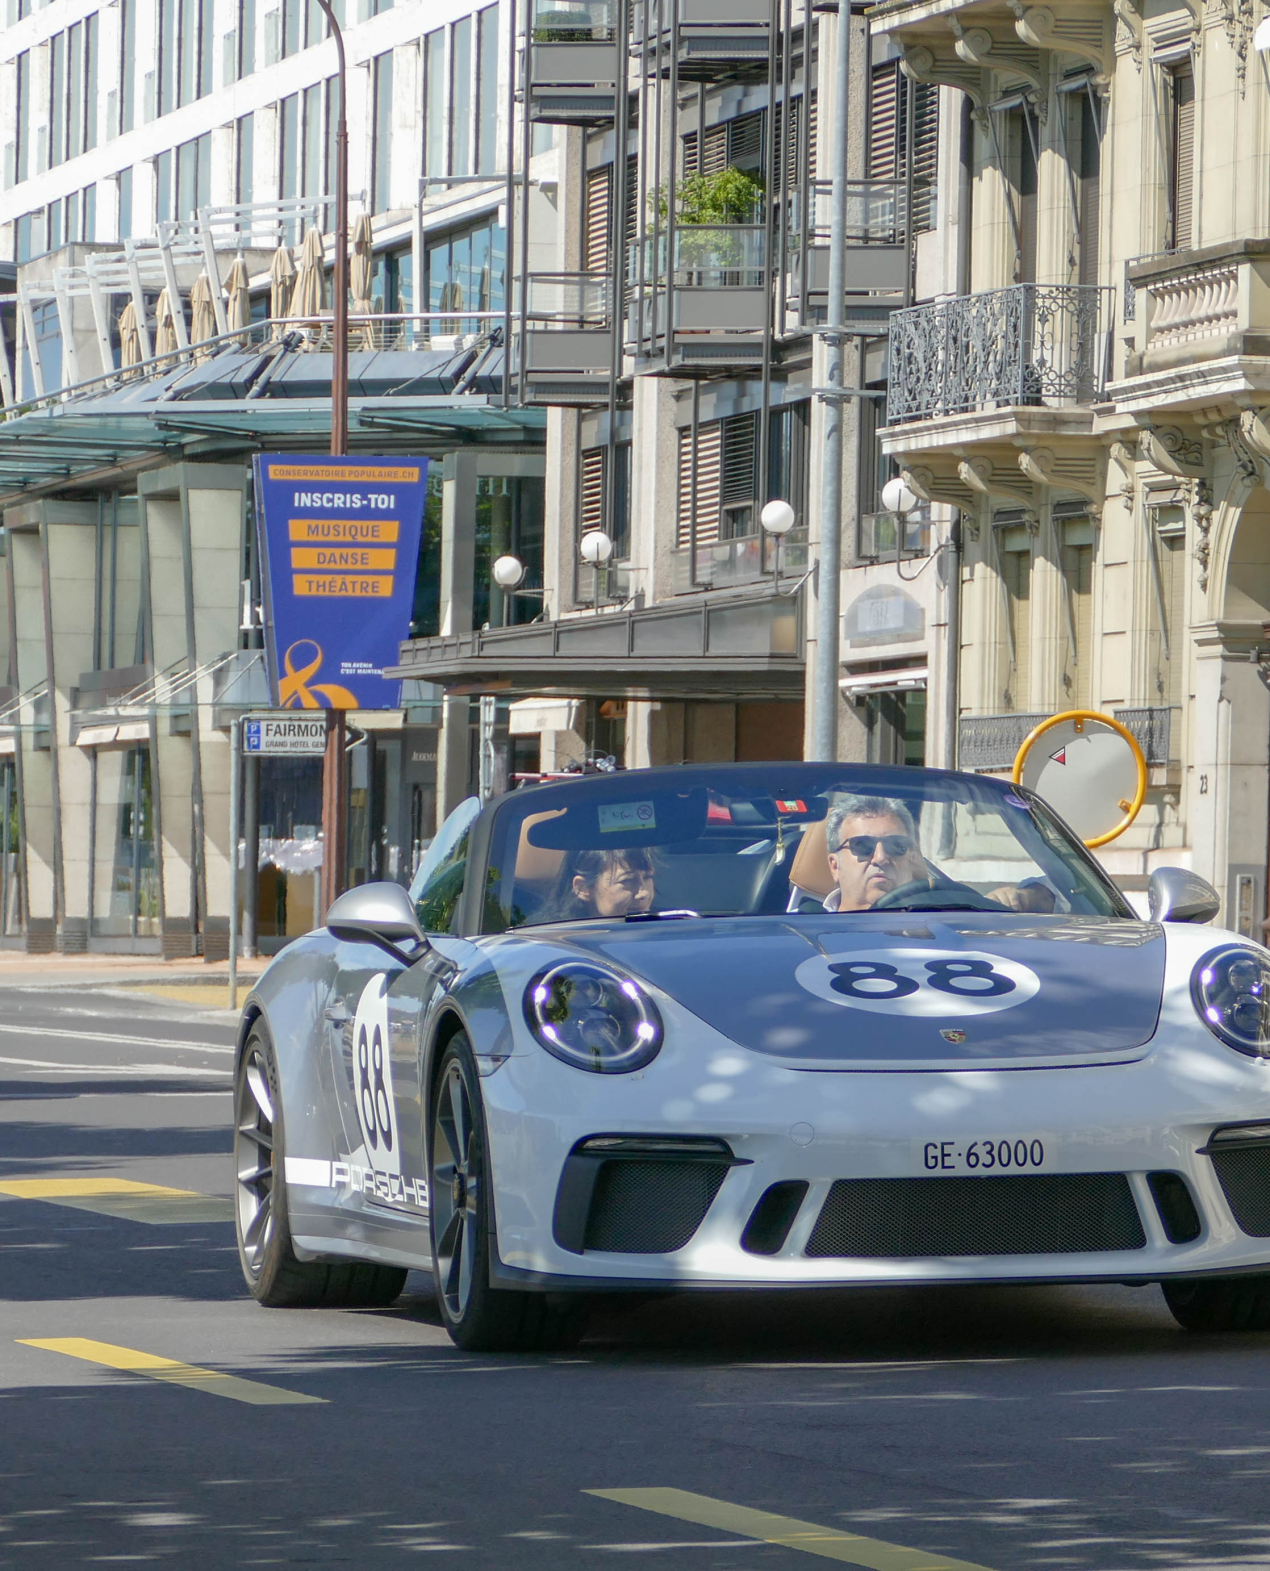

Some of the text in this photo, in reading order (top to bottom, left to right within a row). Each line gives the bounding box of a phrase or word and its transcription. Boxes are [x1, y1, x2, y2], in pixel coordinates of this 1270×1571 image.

[293, 491, 396, 509] INSCRIS-TOI
[306, 523, 381, 541] MUSIQUE
[316, 552, 370, 566] DANSE
[305, 576, 381, 594] THÉÂTRE
[265, 740, 288, 748] GRAND
[289, 740, 310, 749] HOTEL
[1200, 774, 1208, 795] 23
[827, 958, 1018, 1000] 88
[358, 1022, 393, 1154] 88
[331, 1160, 430, 1209] PORSCHE
